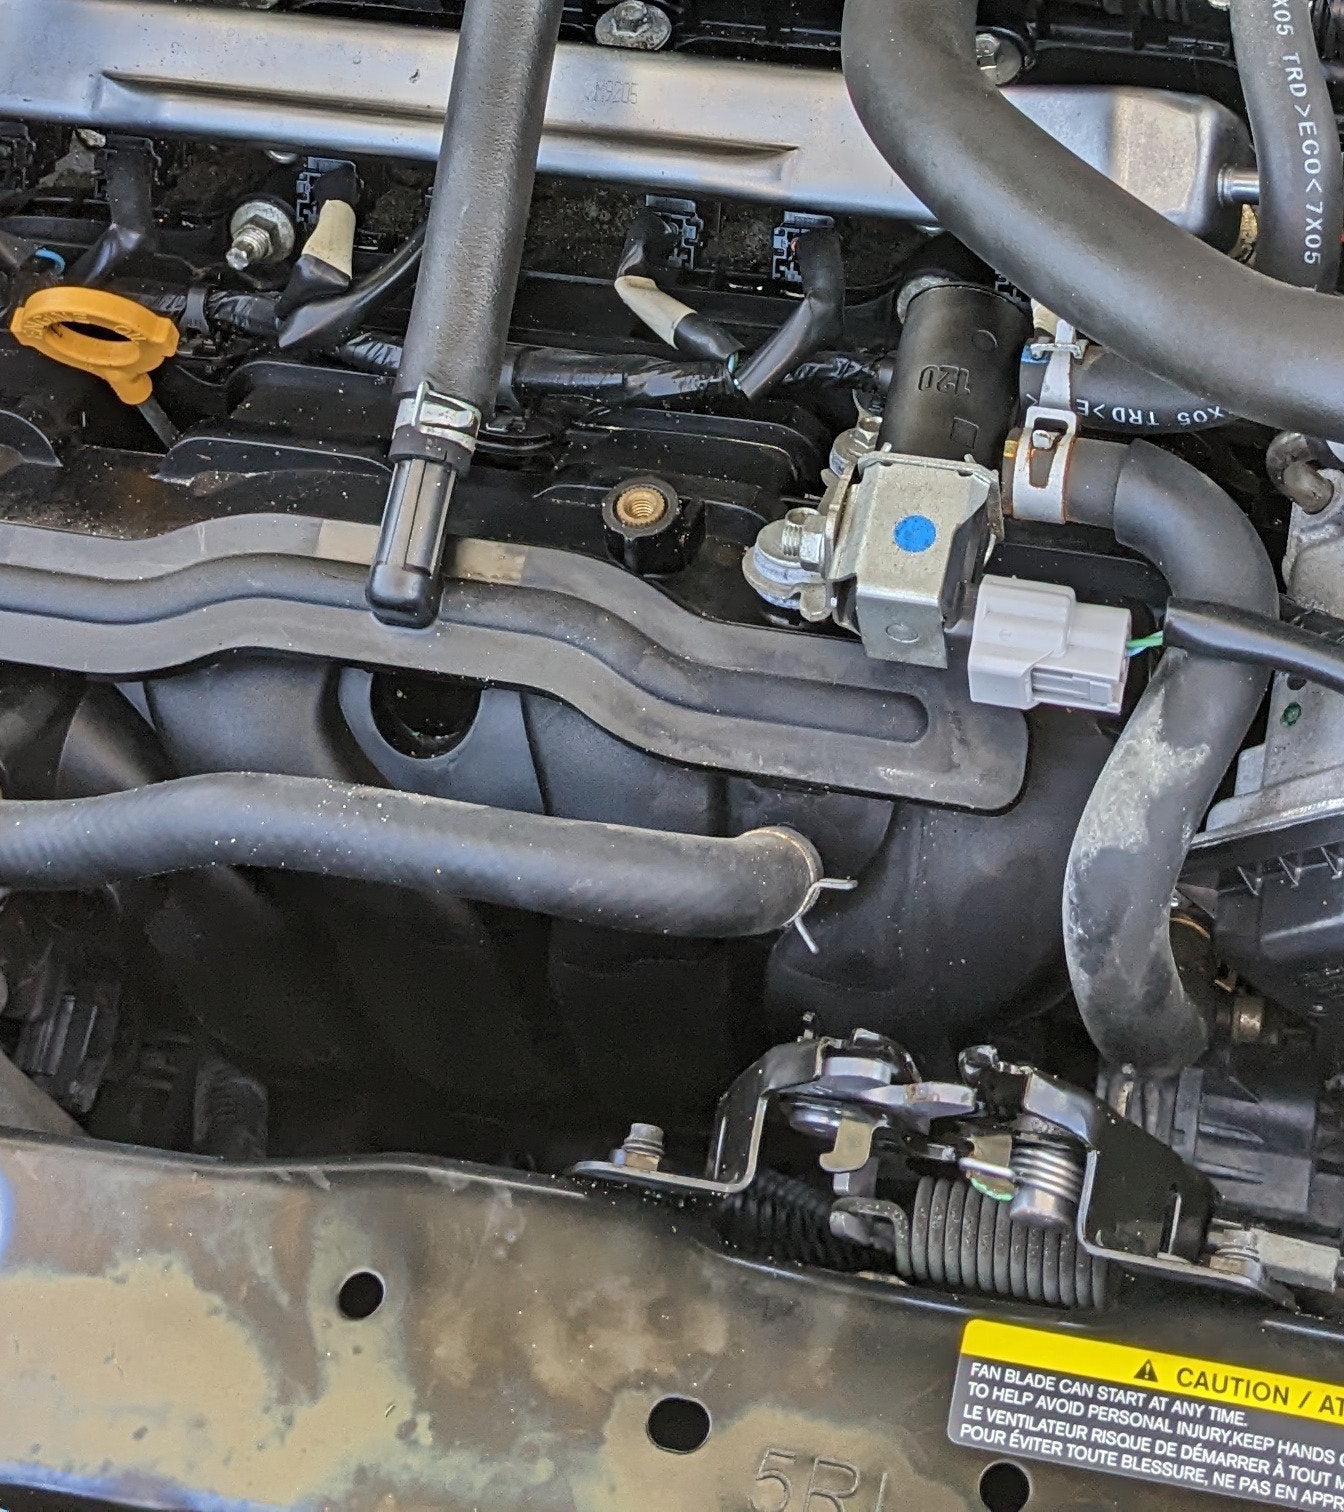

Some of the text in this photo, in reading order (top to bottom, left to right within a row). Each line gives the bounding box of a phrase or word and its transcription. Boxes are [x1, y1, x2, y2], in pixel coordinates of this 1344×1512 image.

[968, 1382, 988, 1400] TO
[992, 1386, 1034, 1408] HELP
[1035, 1392, 1085, 1418] AVOID
[1088, 1405, 1173, 1434] PERSONAL
[1276, 1440, 1336, 1465] HANDS
[970, 1362, 1248, 1428] FAN BLADE CAN START AT ANY TIME.
[1177, 1367, 1290, 1407] CAUTION
[1298, 1391, 1312, 1409] /
[960, 1424, 1007, 1446] POUR
[1009, 1425, 1063, 1456] ÉVITER
[1066, 1441, 1118, 1467] TOUTE
[1121, 1450, 1208, 1486] BLESSURE,
[1213, 1472, 1235, 1489] NE
[1239, 1477, 1271, 1497] PAS
[1275, 1484, 1298, 1500] EN
[963, 1404, 981, 1420] LE
[986, 1407, 1089, 1443] VENTILATEUR
[1091, 1425, 1152, 1454] RISQUE
[1155, 1440, 1176, 1458] DE
[1180, 1442, 1269, 1475] DÉMARRER
[1272, 1455, 1286, 1477] À
[1290, 1466, 1332, 1487] TOUT
